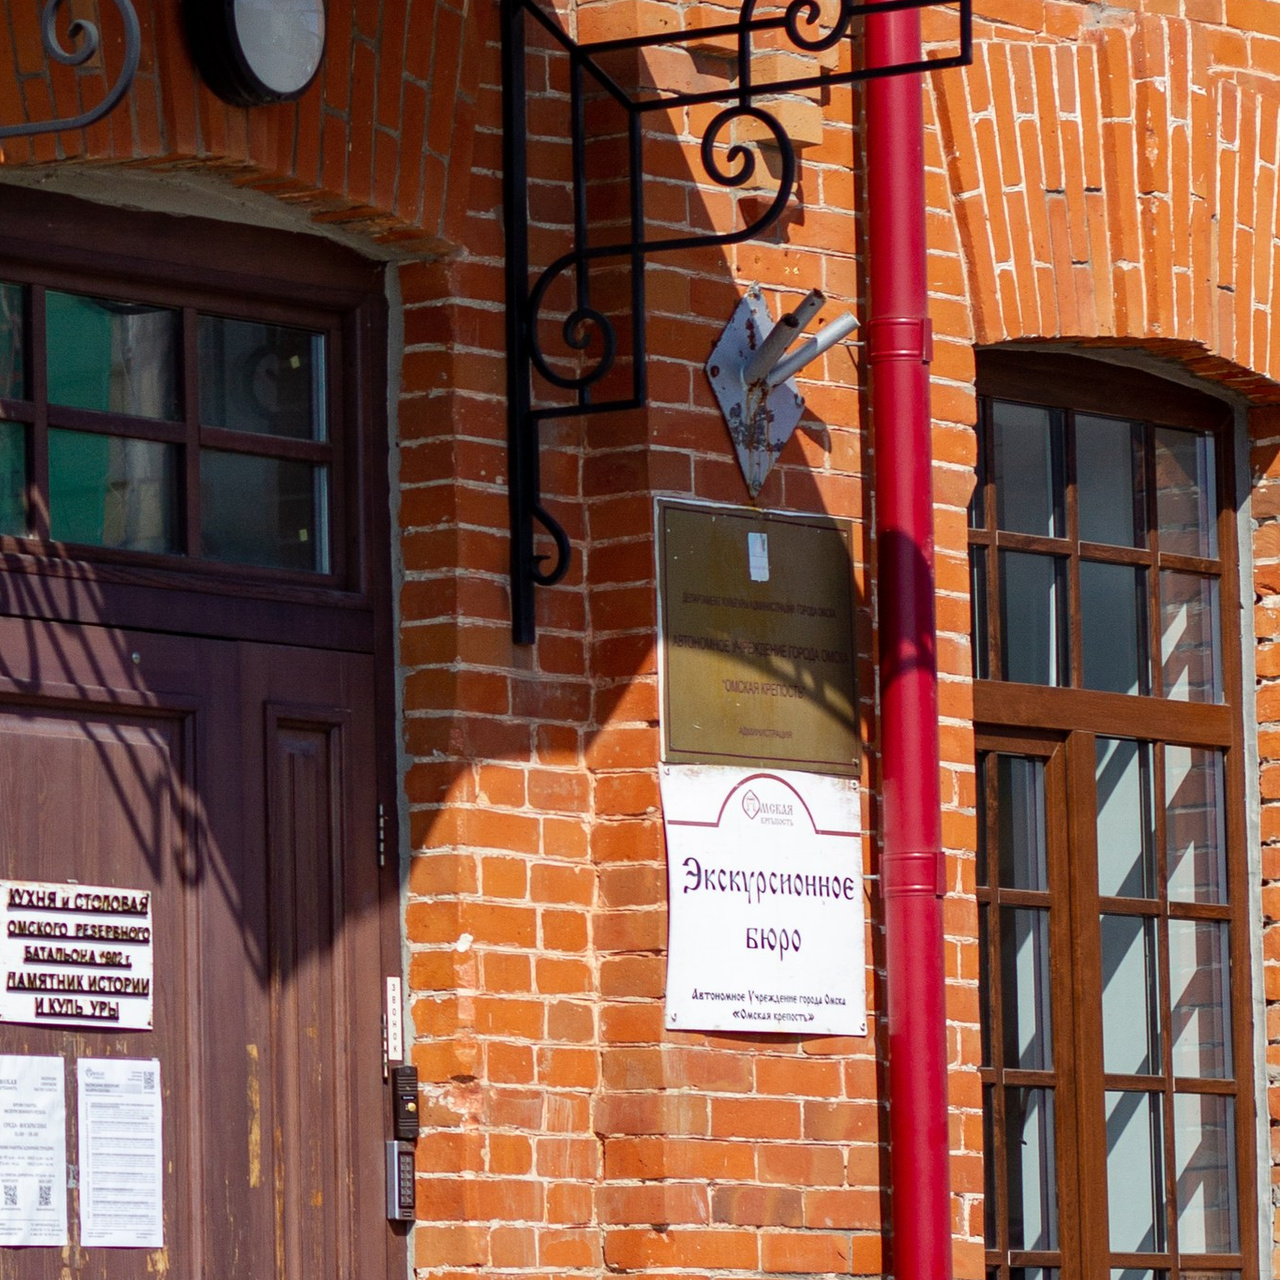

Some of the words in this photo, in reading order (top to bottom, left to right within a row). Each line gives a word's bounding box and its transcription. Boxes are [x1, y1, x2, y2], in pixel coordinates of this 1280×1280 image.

[673, 634, 730, 653] АВТОНОМНОЕ
[731, 639, 788, 658] УЧРЕЖДЕНИЕ
[789, 645, 821, 662] ГОРОДА
[822, 648, 849, 664] ОМСКА
[682, 857, 855, 904] Экскурсионное
[8, 888, 57, 908] КУХНЯ
[74, 893, 149, 913] СТОЛОВАЯ
[7, 920, 68, 936] ОМСКОГО
[75, 923, 151, 941] РЕЗЕРВНОГО
[24, 945, 97, 964] БАТАЛЬОНА
[6, 971, 84, 991] ПАМЯТНИК
[88, 975, 150, 994] ИСТОРИИ
[34, 996, 44, 1013] И
[691, 988, 746, 1002] Автономное
[748, 990, 797, 1005] Учреждение
[799, 995, 822, 1007] города
[824, 994, 846, 1006] Омска
[391, 983, 399, 1054] ЗВОНОК
[732, 1008, 771, 1020] «Омская
